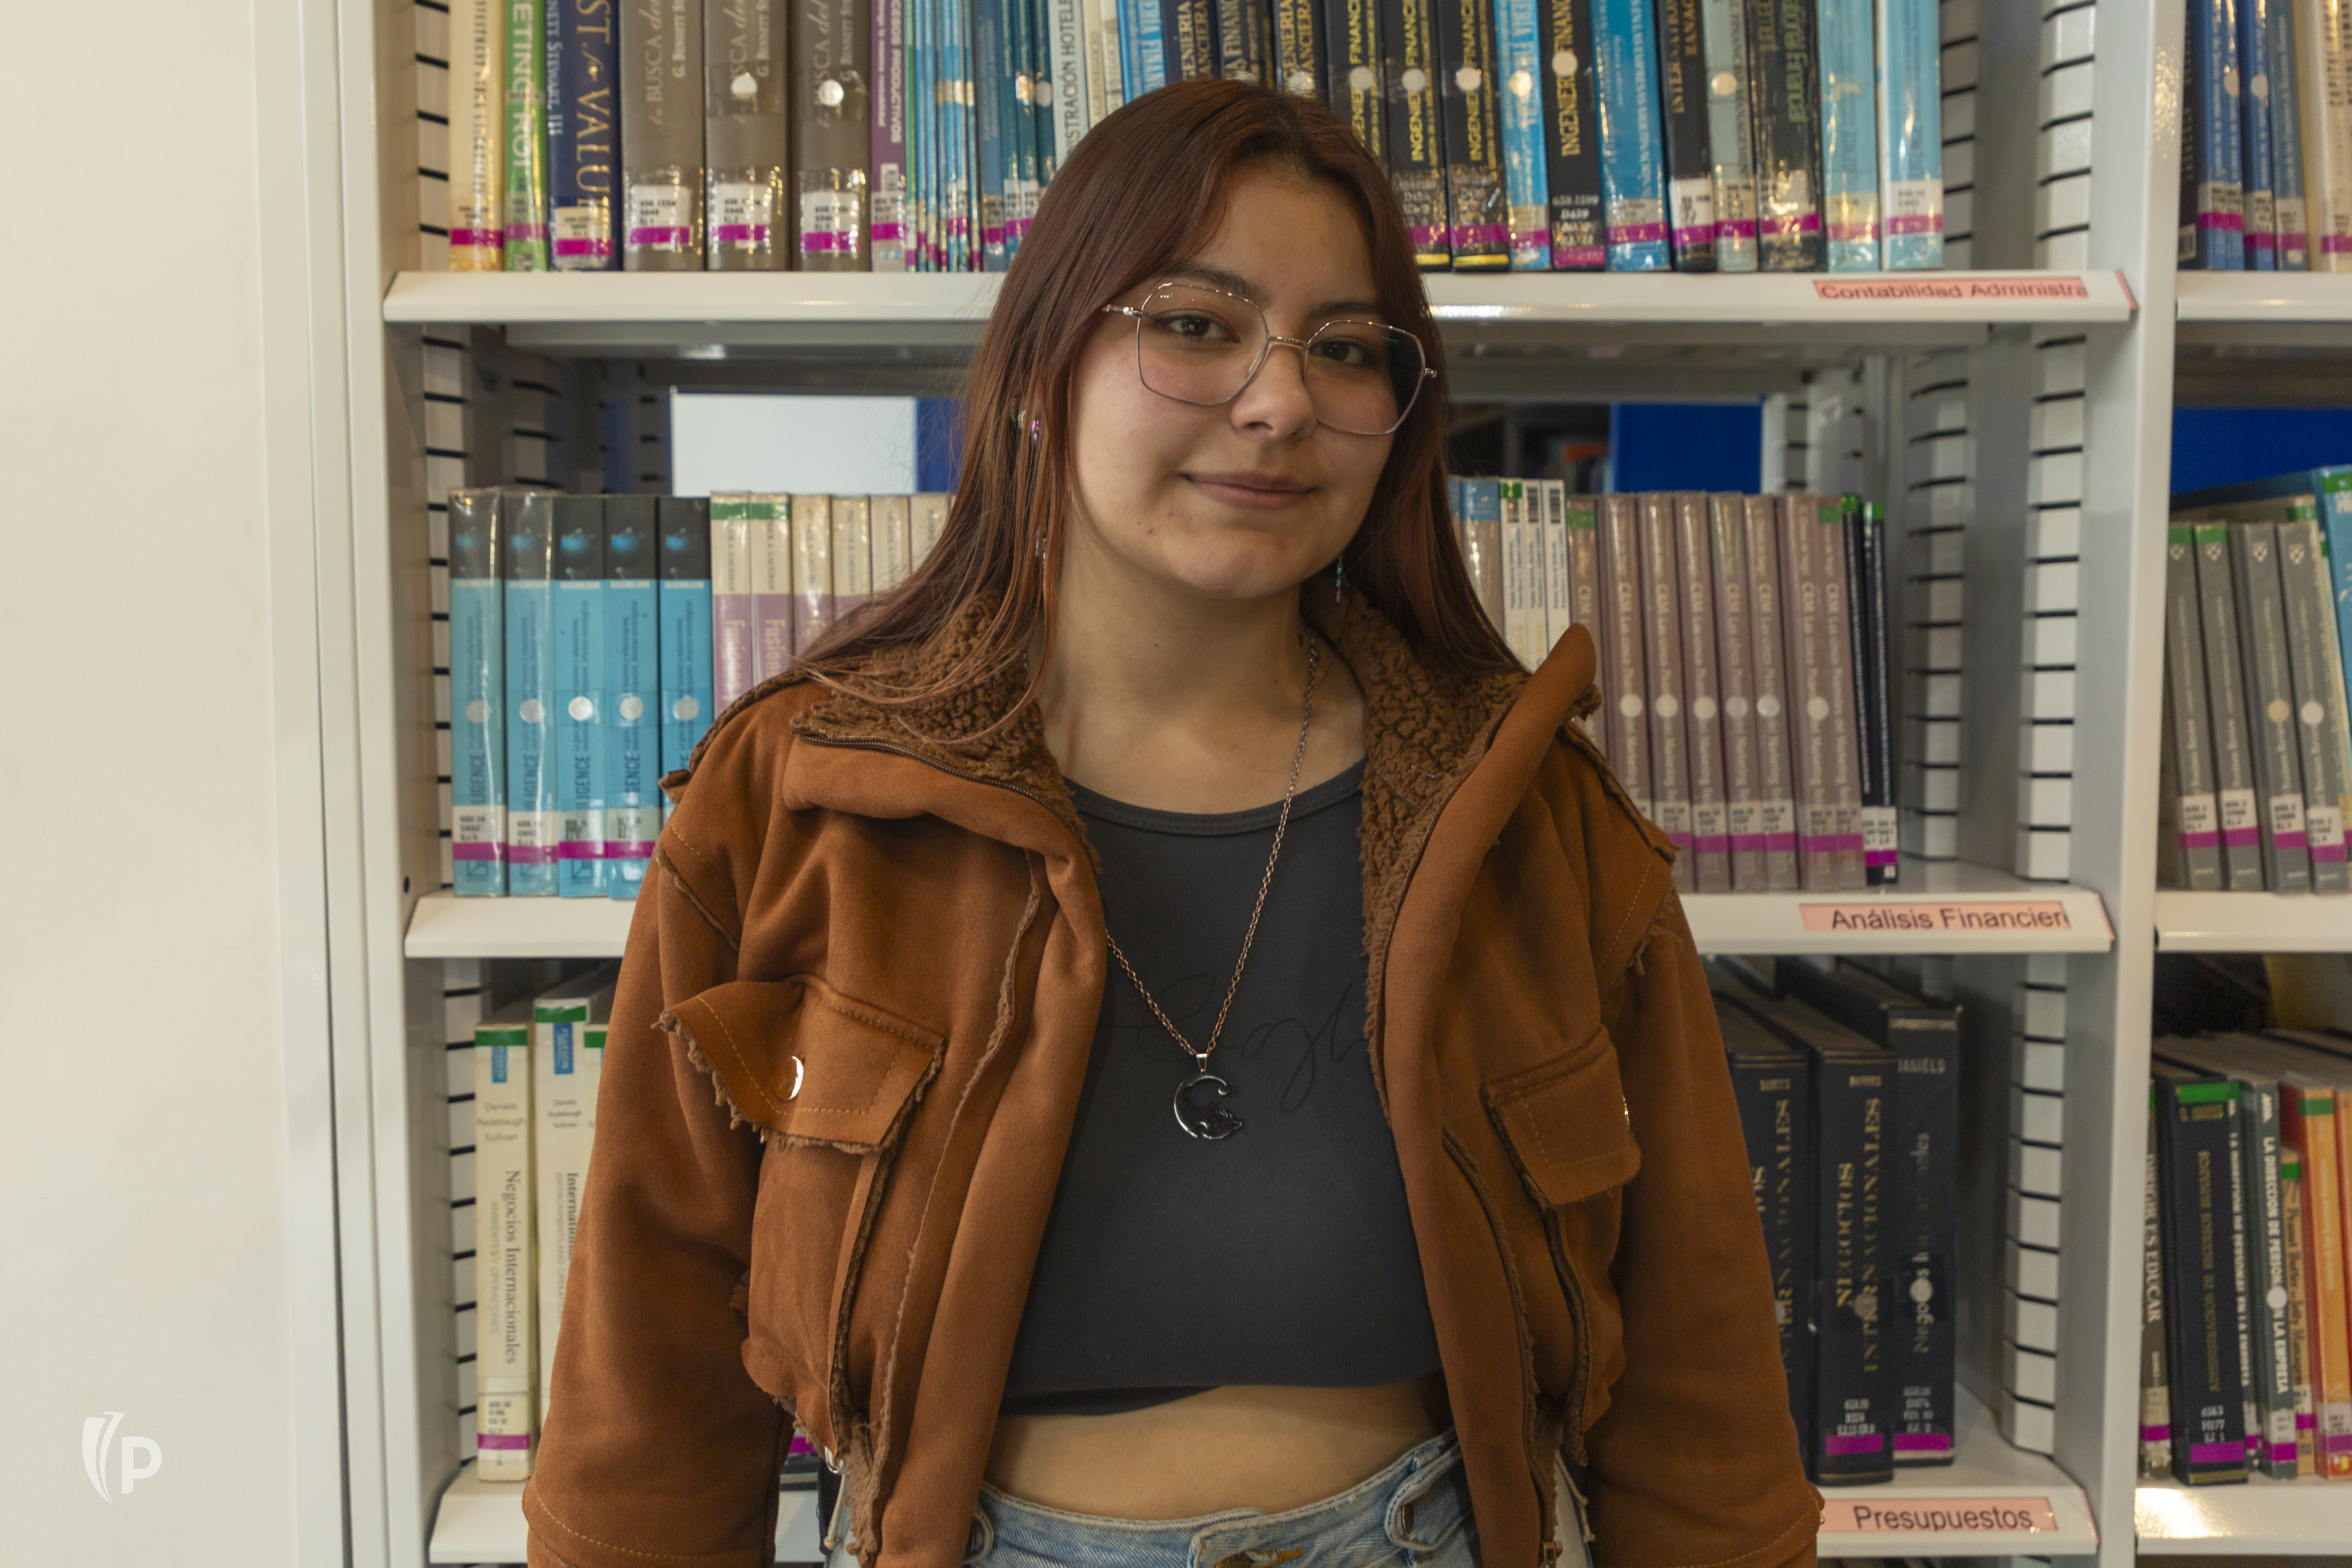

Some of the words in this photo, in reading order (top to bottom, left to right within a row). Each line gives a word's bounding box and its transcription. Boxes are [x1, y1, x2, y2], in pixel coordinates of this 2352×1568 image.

[645, 34, 664, 103] BUSCA
[1821, 283, 1963, 300] Contabilidad
[763, 619, 787, 681] Fusione
[1832, 908, 1933, 930] Análisis
[2262, 1136, 2276, 1153] LA
[501, 1170, 521, 1243] Negocios
[2267, 1219, 2281, 1237] DE
[1836, 1162, 1854, 1308] NEGOCIOS
[2145, 1250, 2162, 1323] EDUCAR
[2268, 1238, 2283, 1290] PERSON
[505, 1248, 521, 1365] Internacionales
[2272, 1321, 2287, 1338] LA
[1853, 1505, 2034, 1531] Presupuestos
